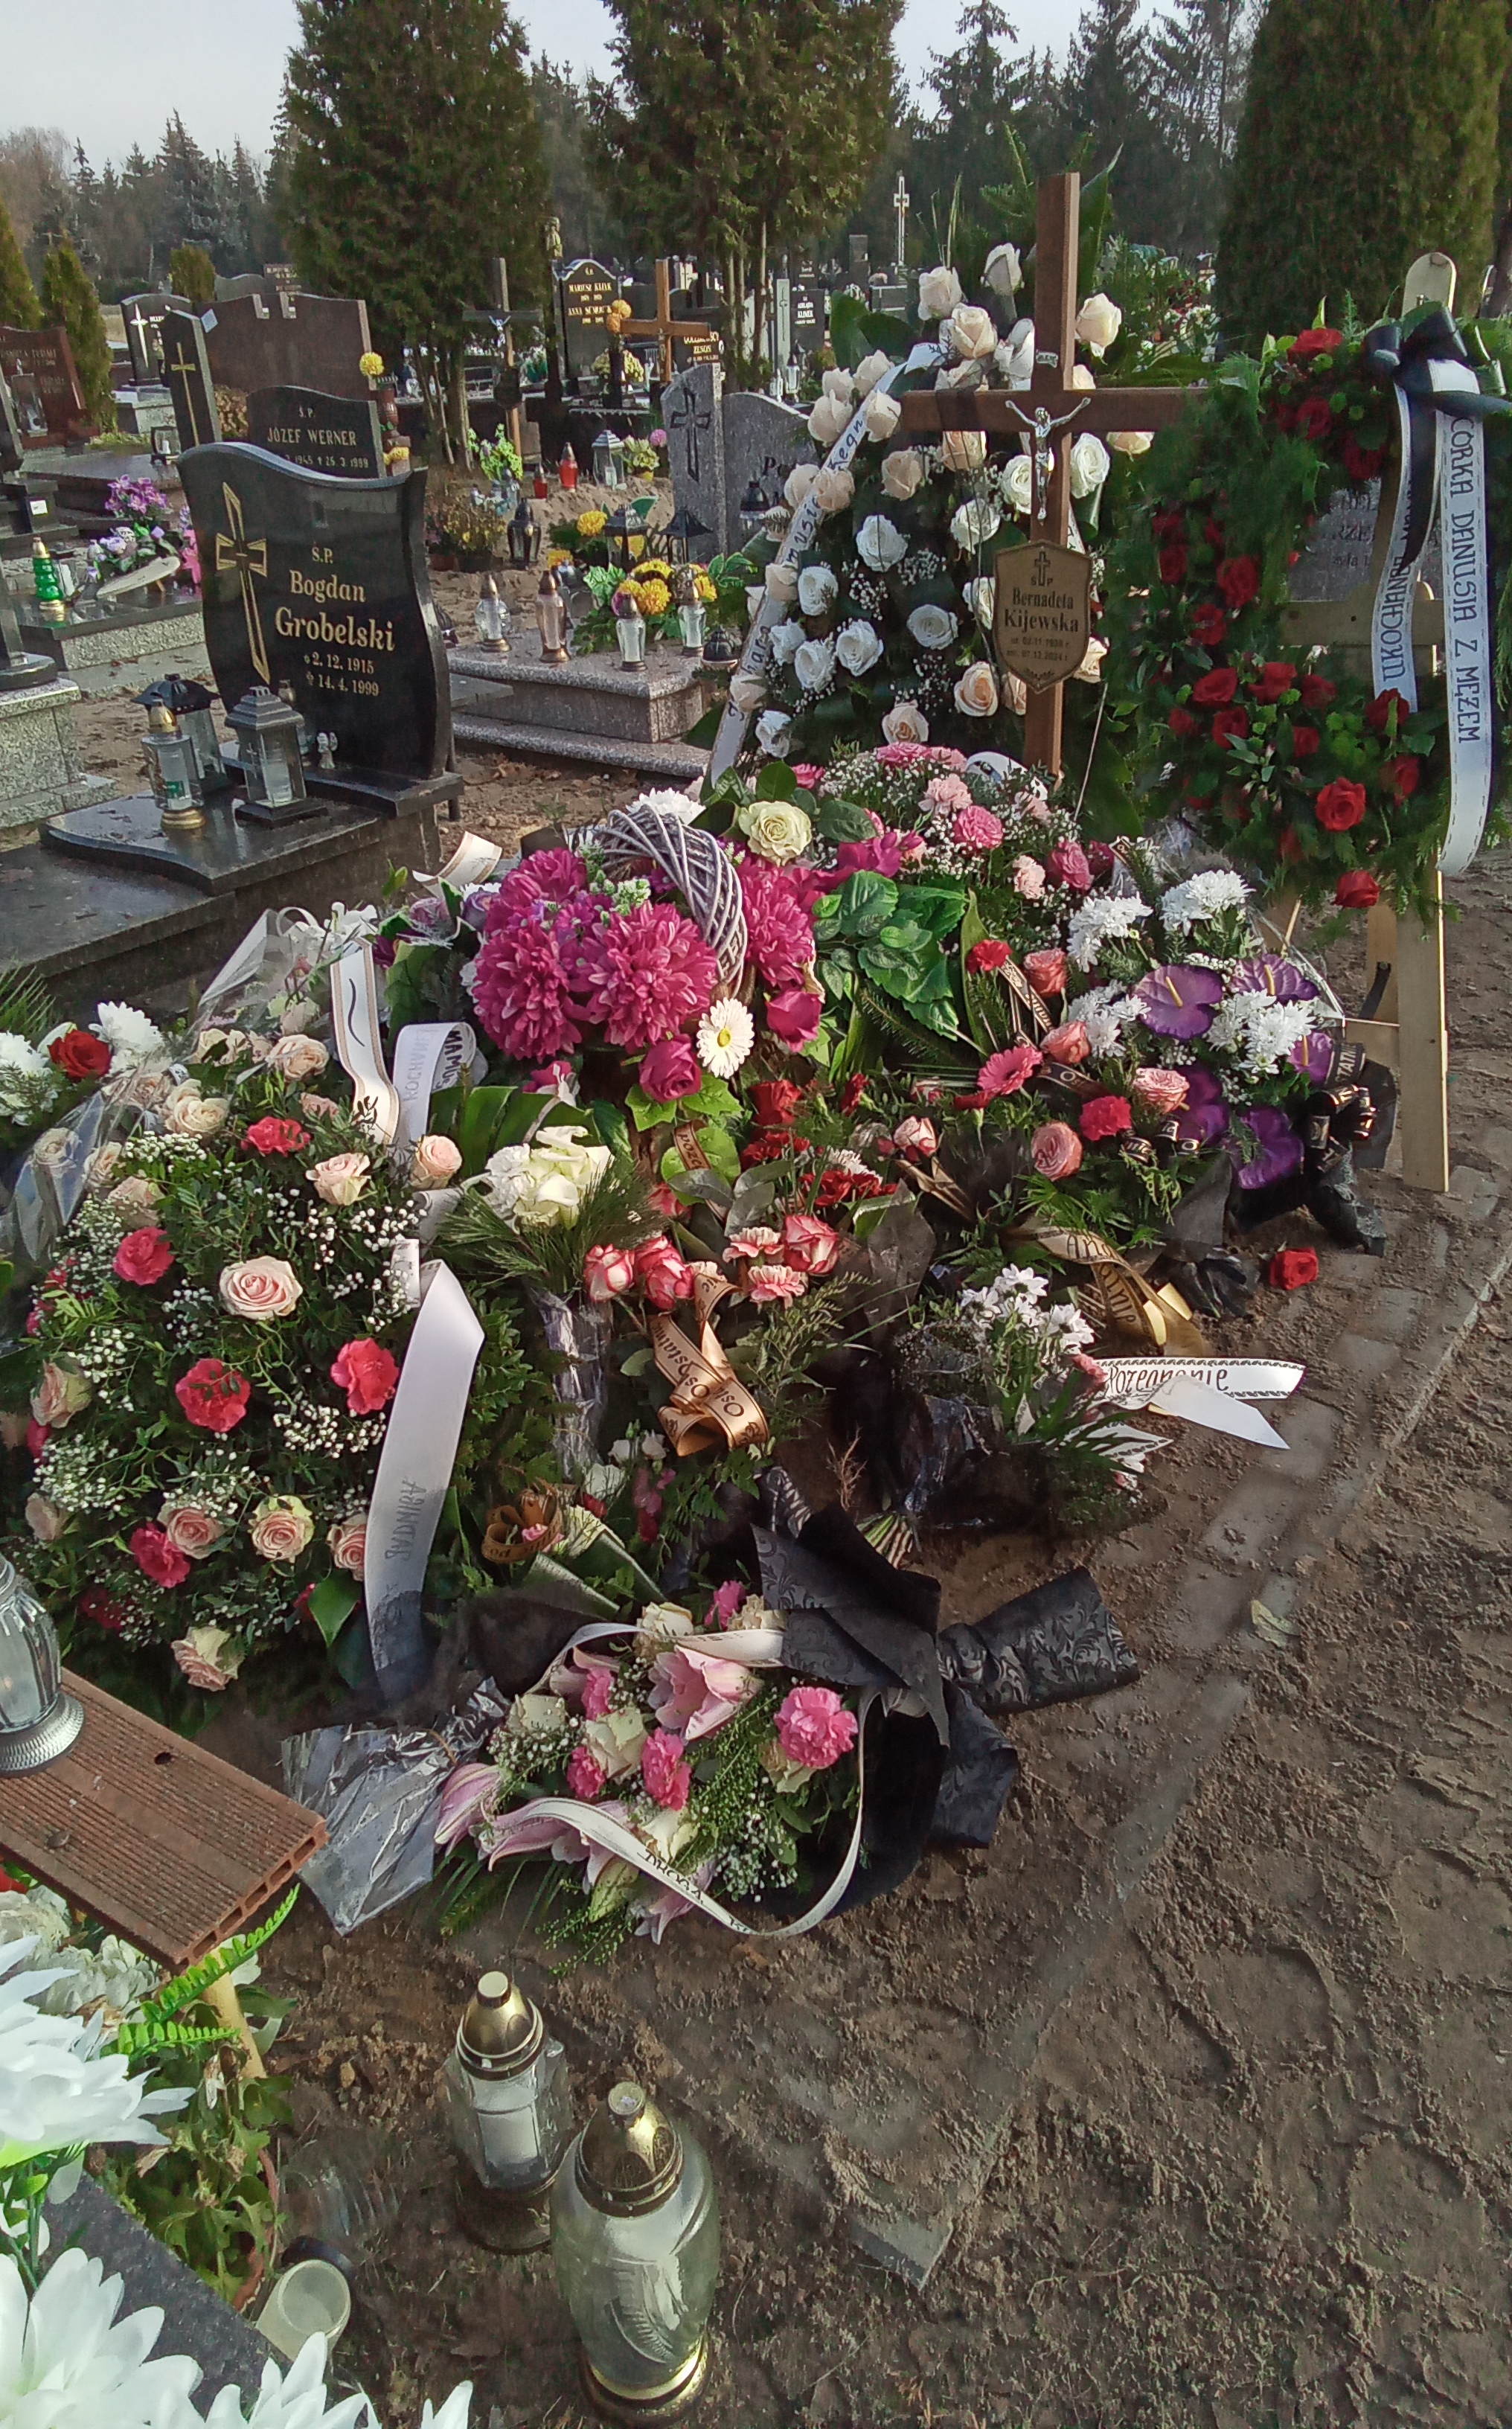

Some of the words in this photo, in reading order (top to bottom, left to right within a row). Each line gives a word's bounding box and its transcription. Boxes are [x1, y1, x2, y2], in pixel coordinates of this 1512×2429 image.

[267, 426, 301, 444] JÓZEF
[307, 429, 356, 446] WERNER
[1451, 510, 1478, 623] DANUSIA
[289, 569, 366, 603] Bogdan
[1013, 586, 1074, 609] Bernadeta
[275, 606, 395, 651] Grobelski
[1005, 608, 1079, 633] Kijewska
[1455, 639, 1478, 657] Z
[347, 657, 374, 674] 1915
[352, 679, 379, 697] 1999
